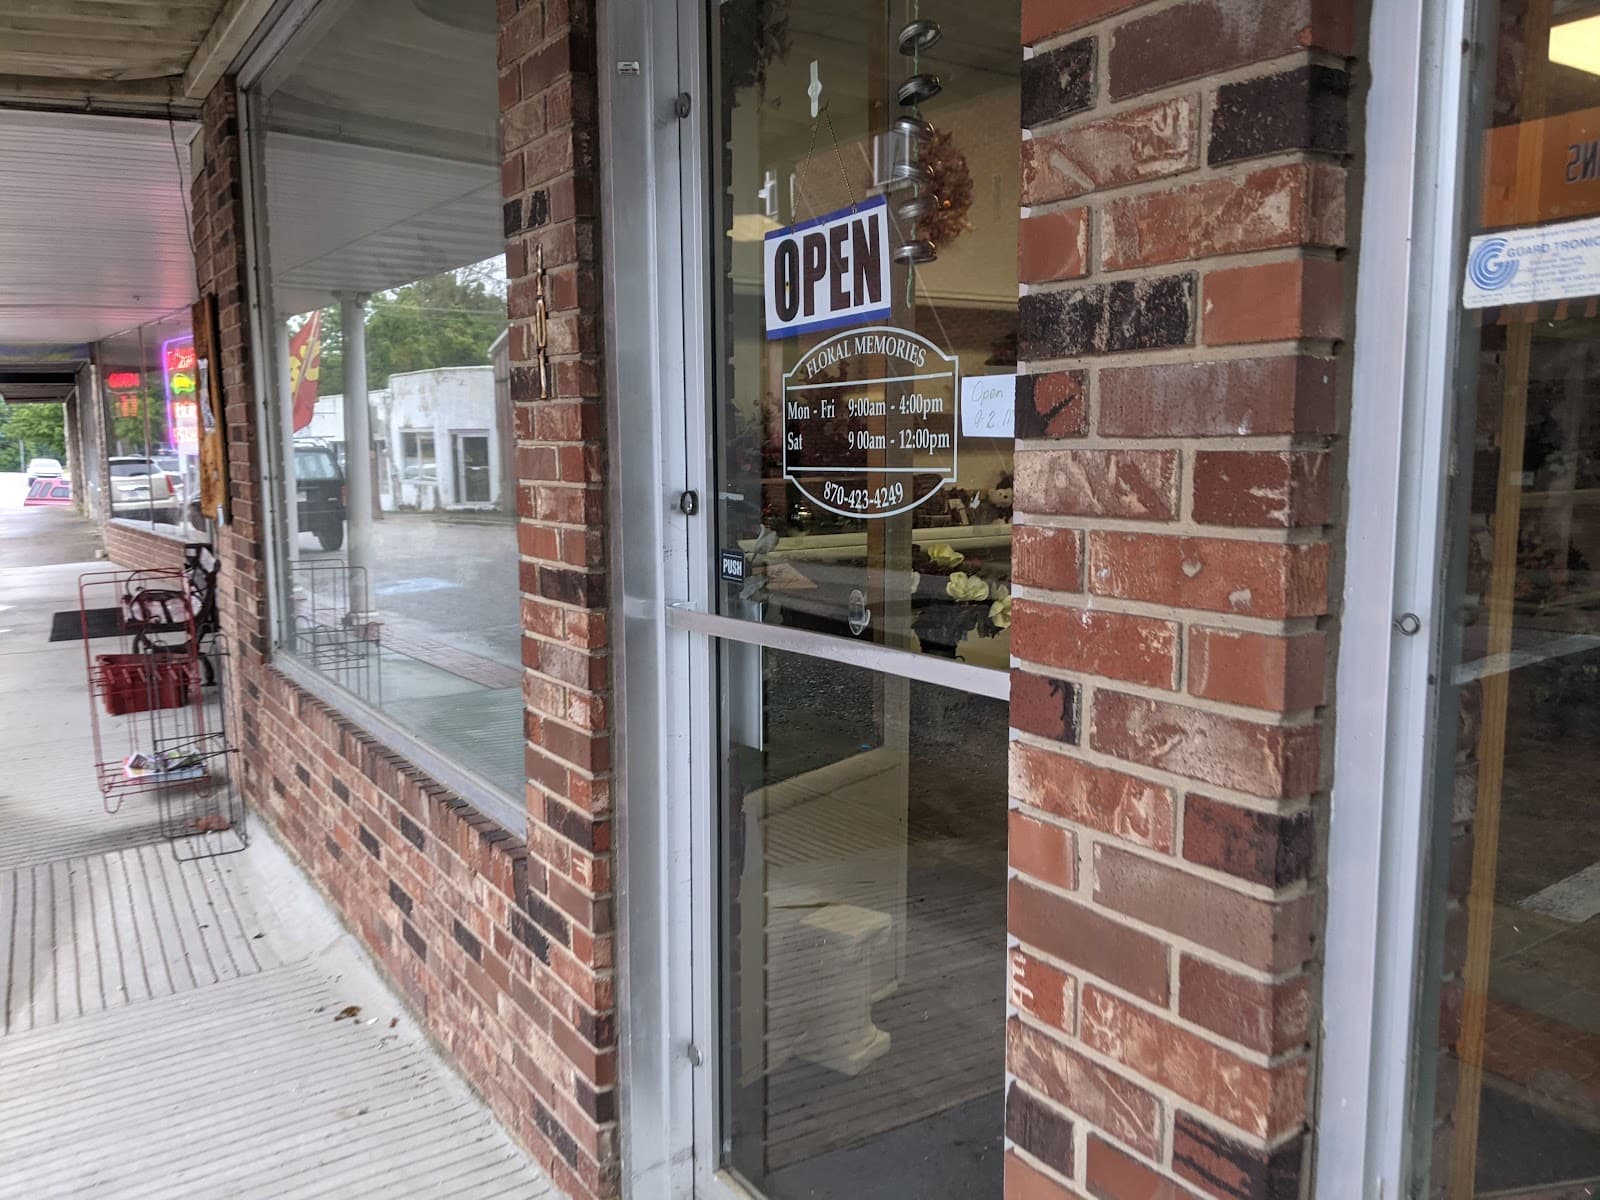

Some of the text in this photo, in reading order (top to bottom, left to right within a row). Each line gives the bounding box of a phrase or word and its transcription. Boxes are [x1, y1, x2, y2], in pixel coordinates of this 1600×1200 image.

[1507, 243, 1550, 257] GUARD
[774, 214, 882, 322] OPEN
[854, 336, 927, 368] MEMORIES
[787, 402, 810, 420] Mon
[821, 399, 836, 418] Fri
[848, 398, 886, 417] 9:00am
[899, 393, 943, 420] 4:00pm
[971, 380, 1004, 407] Open
[787, 432, 803, 450] Sat
[899, 428, 950, 455] 12:00pm
[823, 480, 904, 510] 870-423-4249
[722, 558, 743, 577] PUSH
